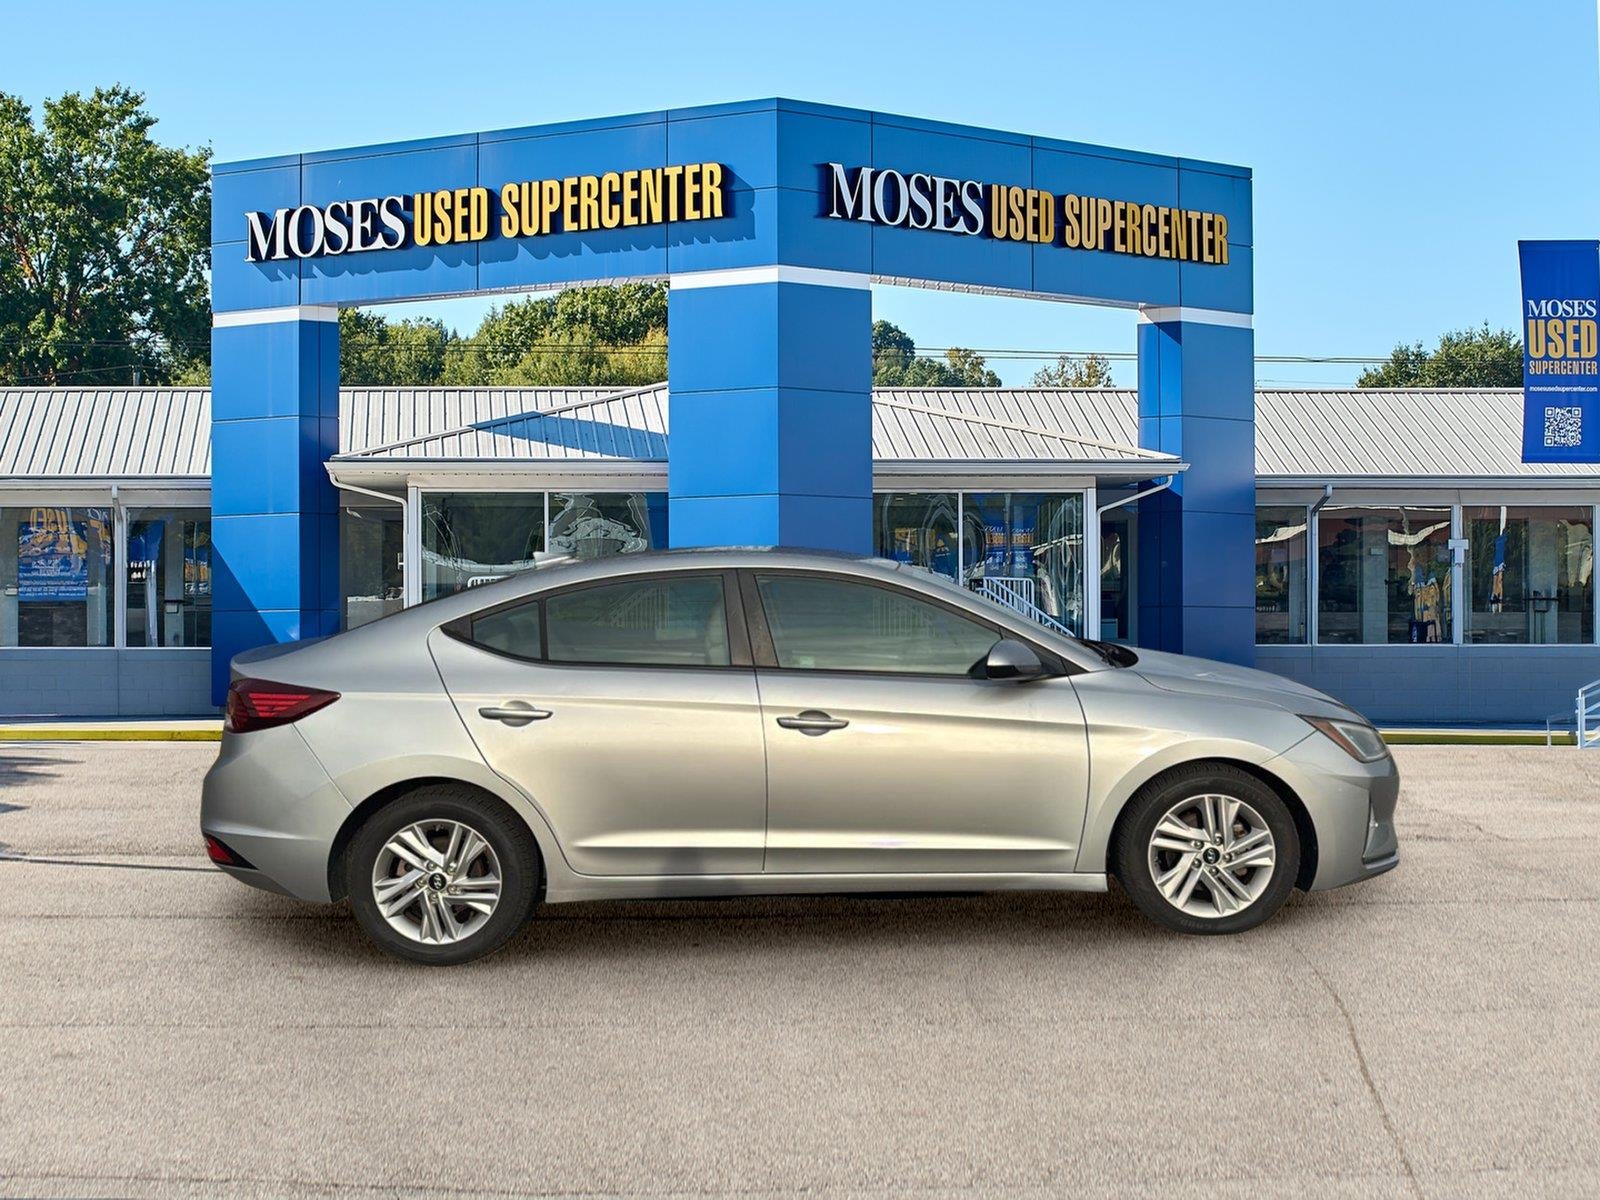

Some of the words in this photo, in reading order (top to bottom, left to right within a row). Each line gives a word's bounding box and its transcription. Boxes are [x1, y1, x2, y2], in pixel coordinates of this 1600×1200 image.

[244, 194, 408, 263] MOSES
[413, 187, 489, 246] USED
[501, 162, 724, 238] SUPERCENTER
[828, 162, 985, 236] MOSES
[991, 183, 1055, 243] USED
[1064, 193, 1230, 265] SUPERCENTER
[1527, 299, 1597, 318] MOSES
[1528, 319, 1598, 359] USED
[1529, 360, 1598, 375] SUPERCENTER
